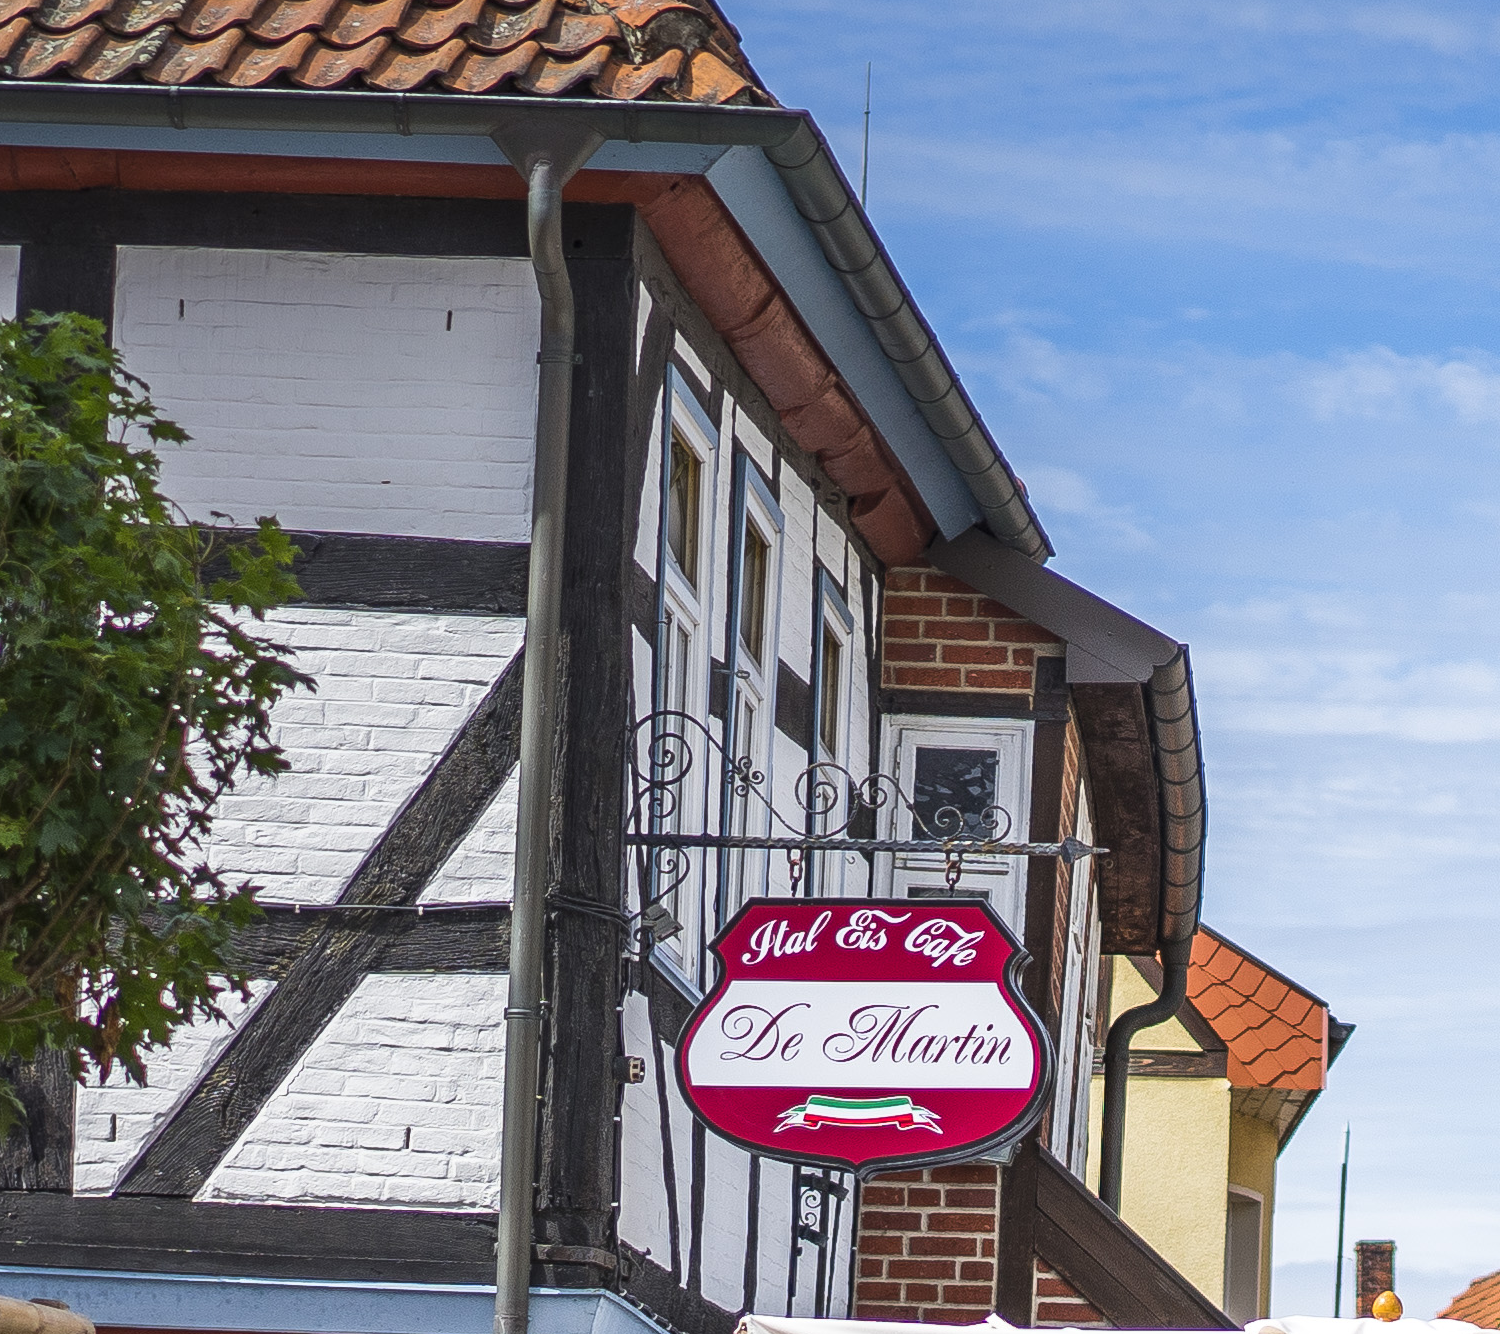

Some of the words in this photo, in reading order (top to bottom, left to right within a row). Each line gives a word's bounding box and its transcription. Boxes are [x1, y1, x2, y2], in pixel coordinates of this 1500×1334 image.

[742, 910, 832, 965] Ital
[835, 909, 912, 950] Eis
[720, 1003, 812, 1062] De
[822, 1003, 1013, 1066] Martin
